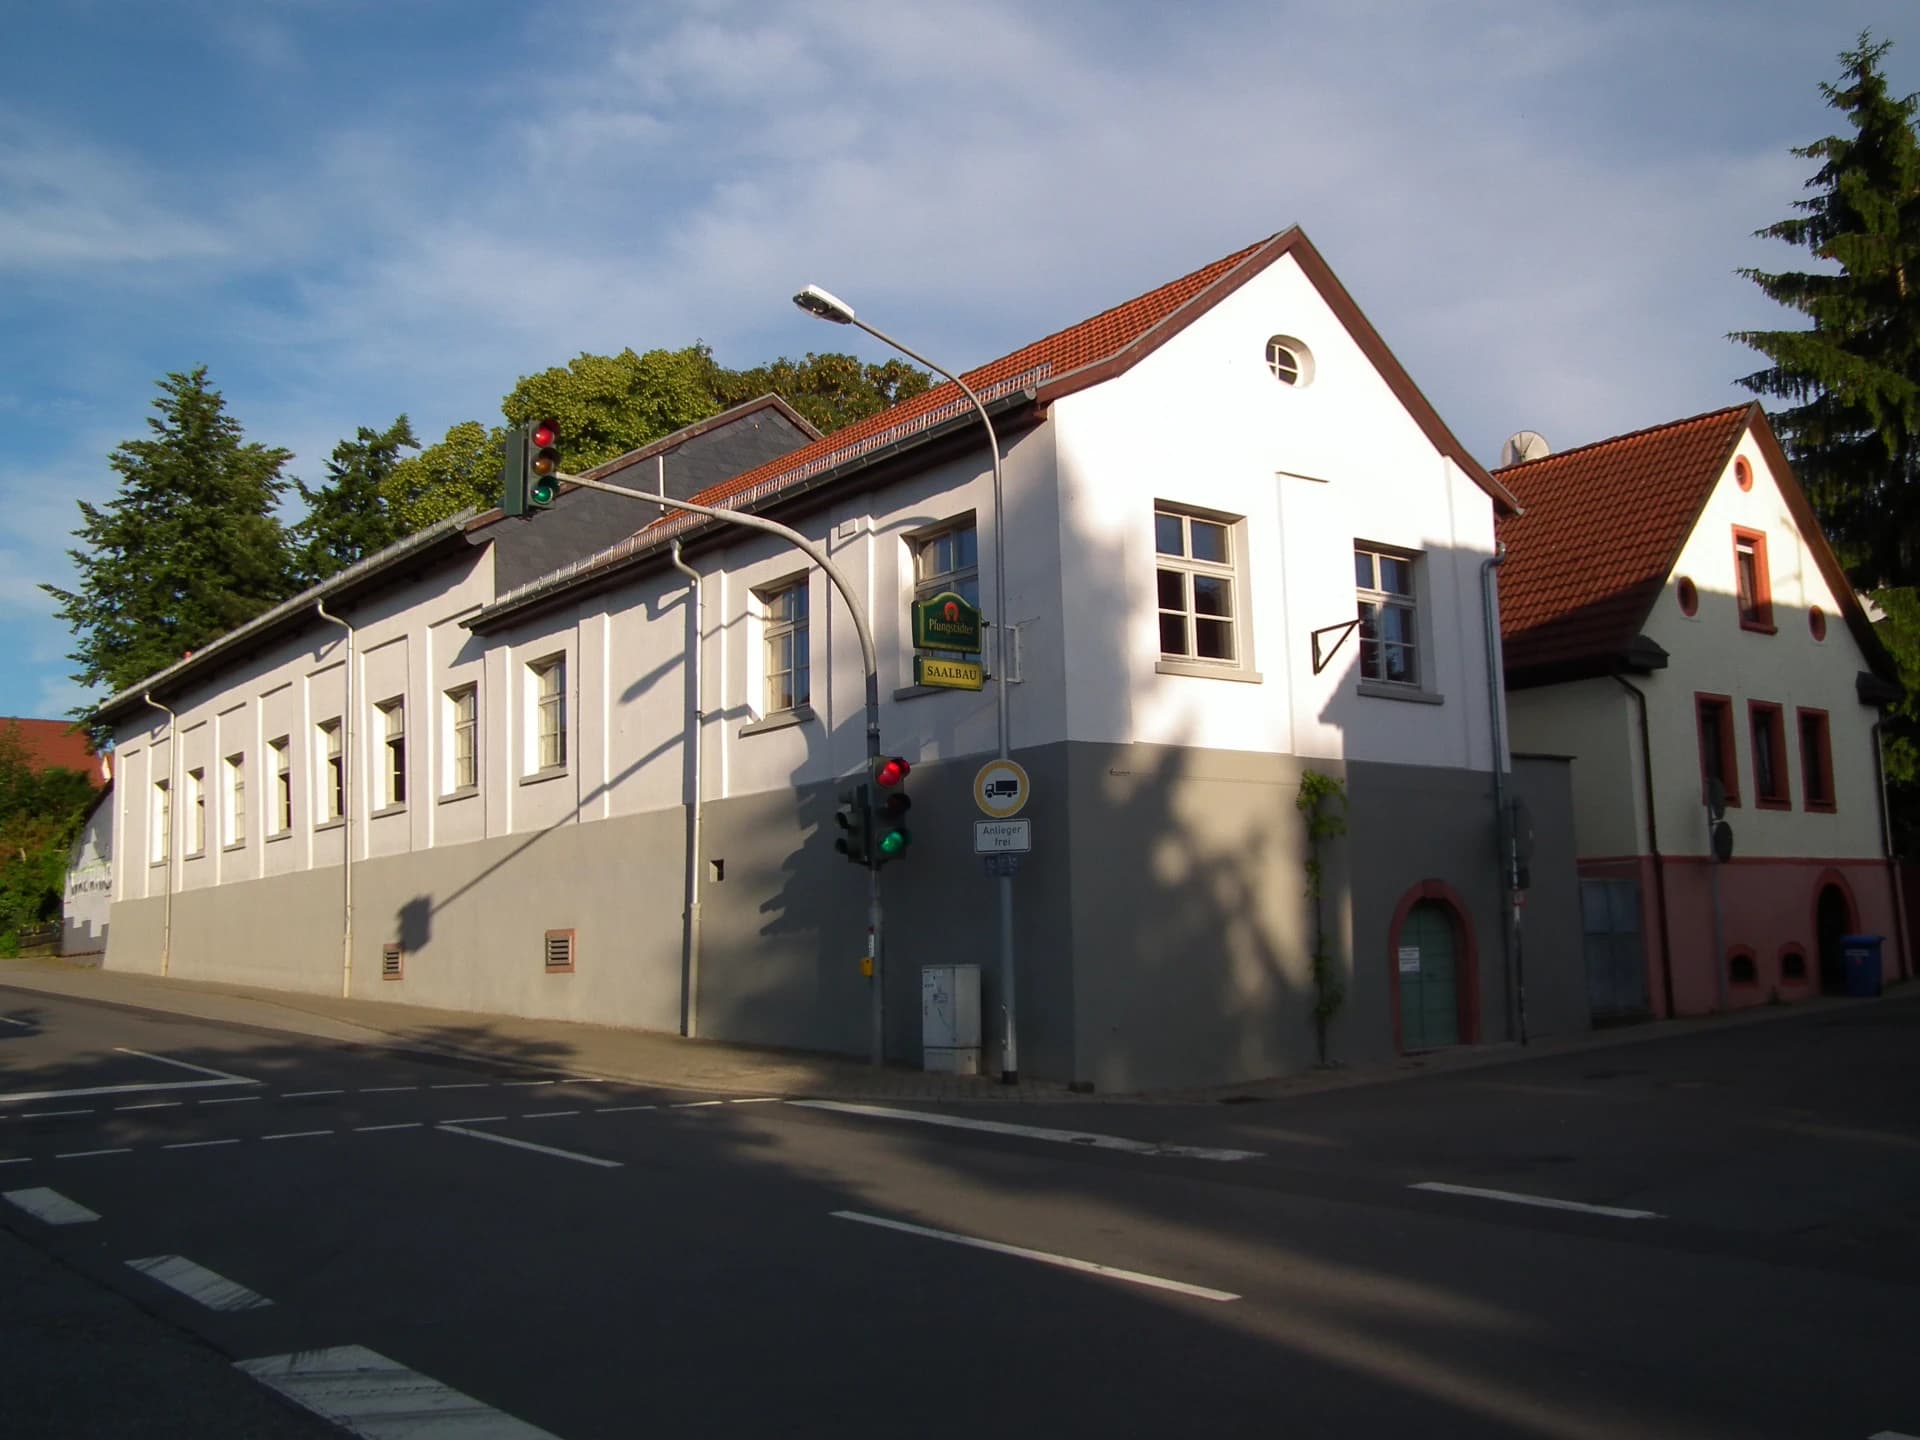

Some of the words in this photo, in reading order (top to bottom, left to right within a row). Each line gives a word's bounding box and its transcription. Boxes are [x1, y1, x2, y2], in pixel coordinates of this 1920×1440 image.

[927, 665, 977, 680] SAALBAU
[983, 825, 1022, 836] Anlieger
[994, 838, 1011, 847] frei
